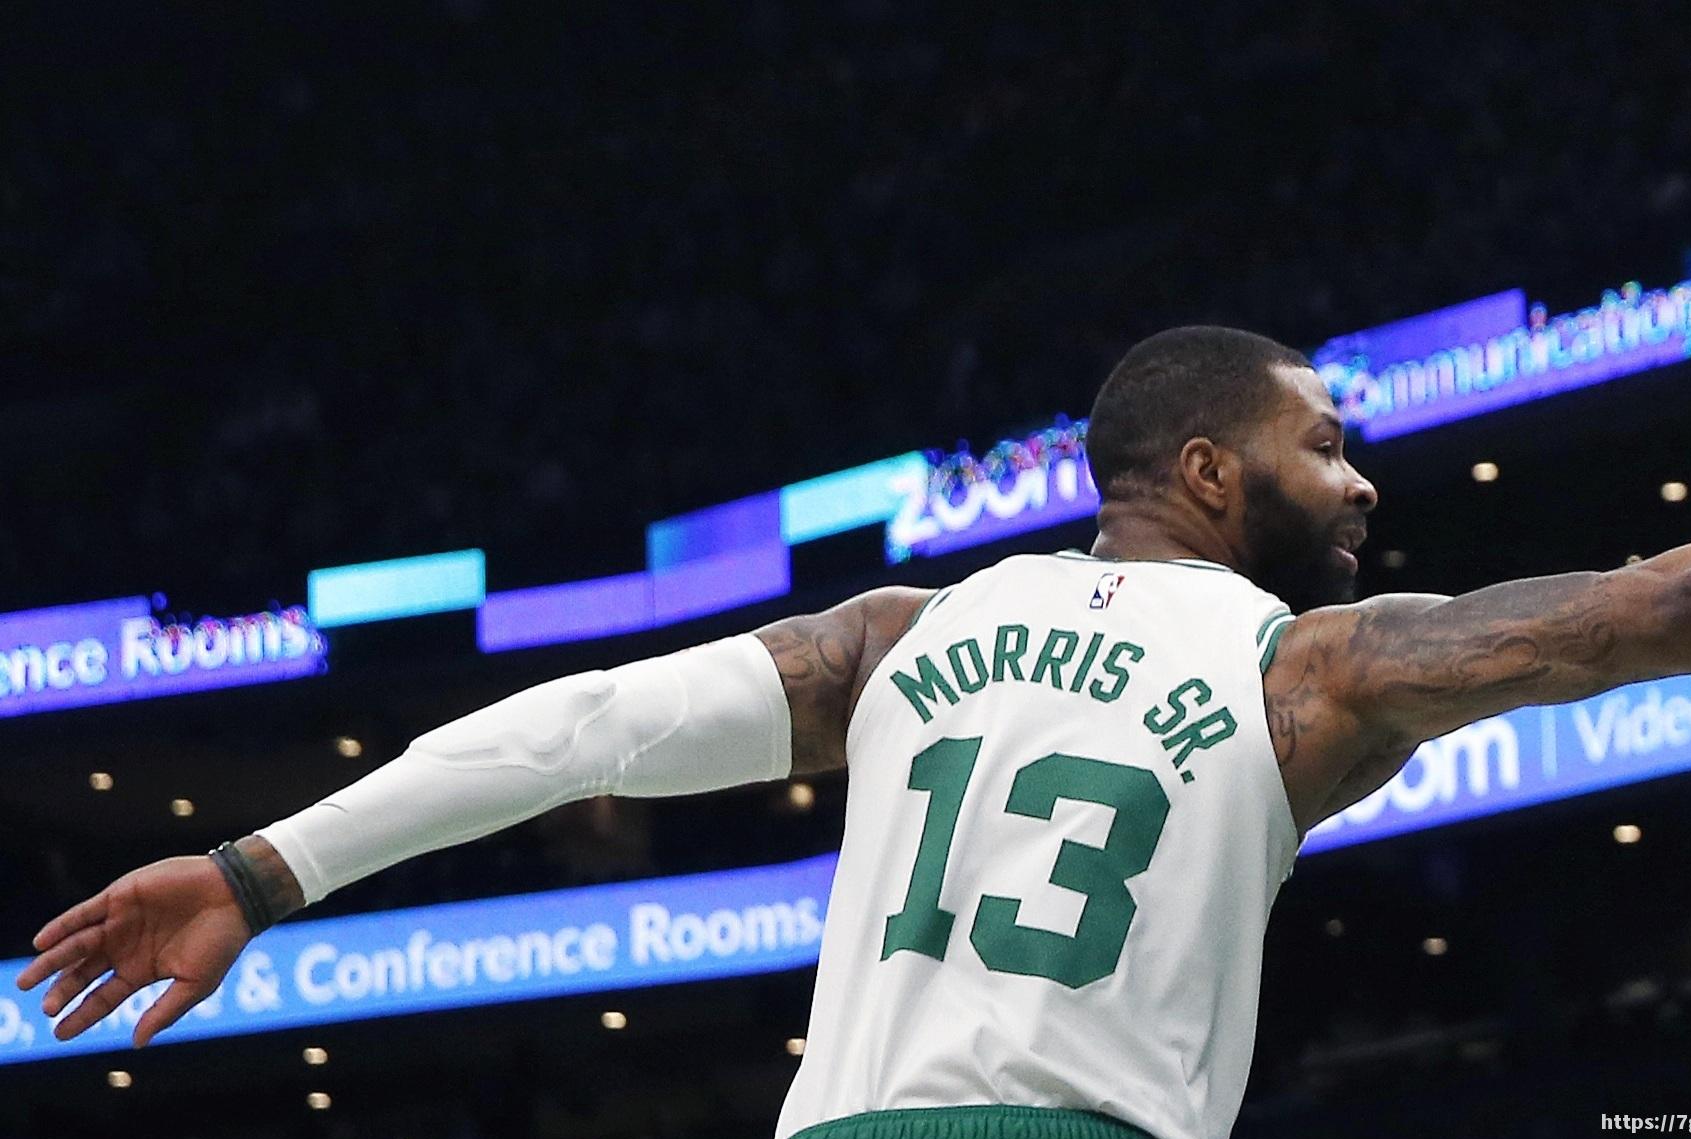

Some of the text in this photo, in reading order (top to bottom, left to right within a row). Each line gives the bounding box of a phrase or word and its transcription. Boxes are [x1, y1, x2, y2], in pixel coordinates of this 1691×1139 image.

[890, 624, 1238, 785] MORRIS SR.
[880, 736, 1170, 989] 13
[235, 949, 283, 1013] &
[295, 923, 618, 1002] Conference
